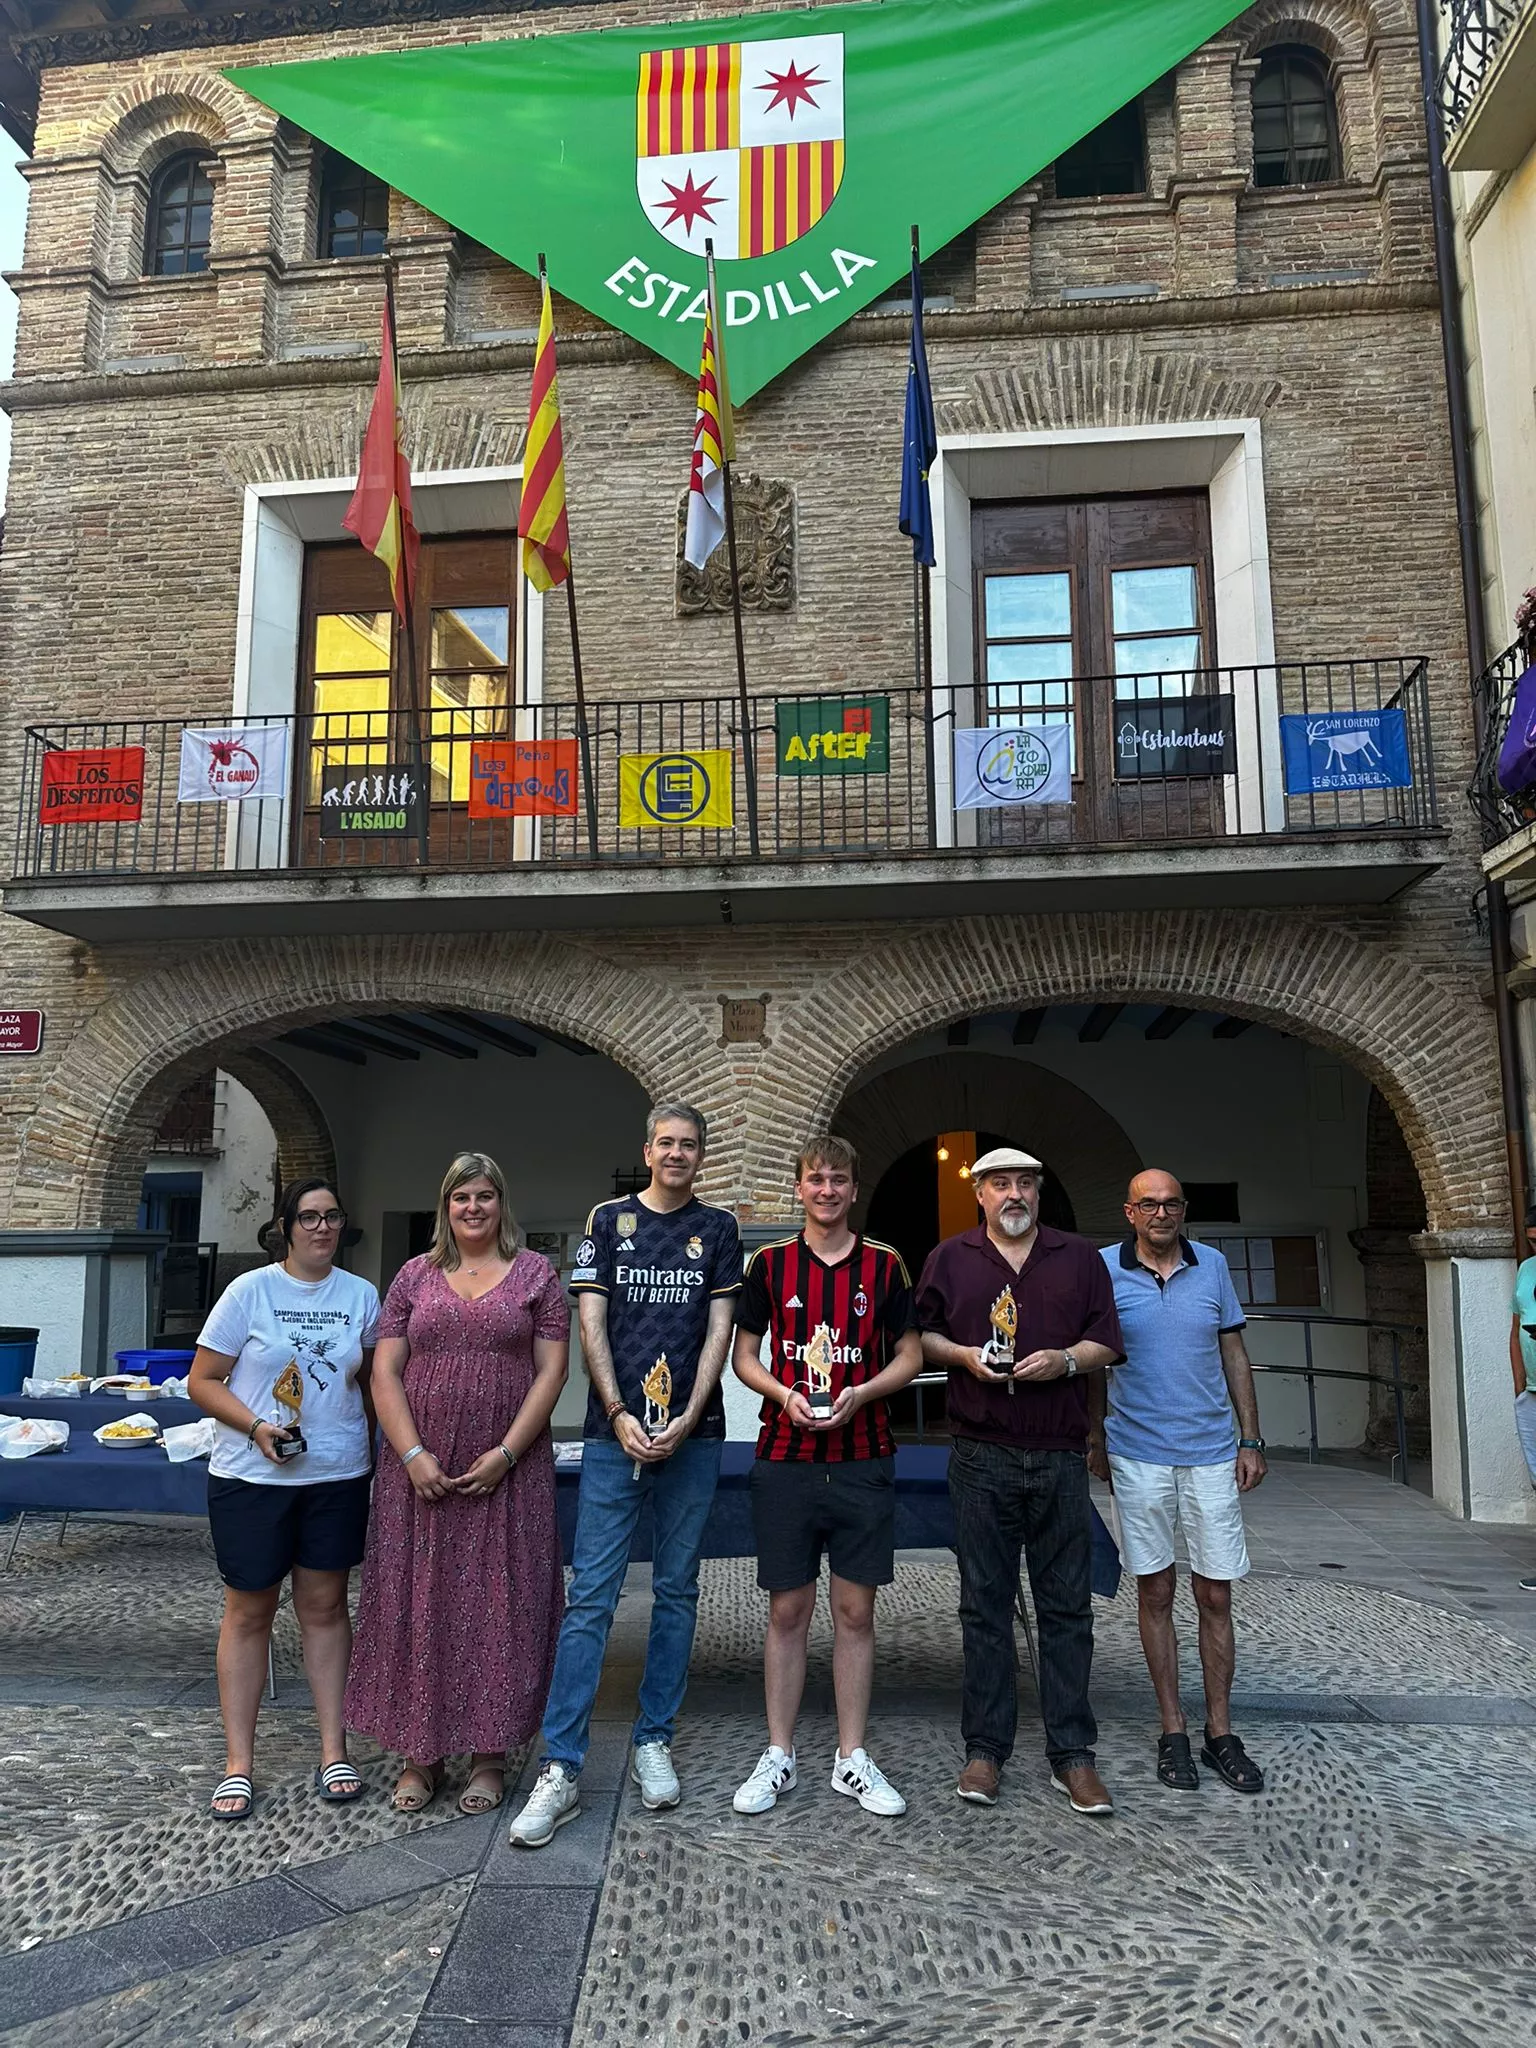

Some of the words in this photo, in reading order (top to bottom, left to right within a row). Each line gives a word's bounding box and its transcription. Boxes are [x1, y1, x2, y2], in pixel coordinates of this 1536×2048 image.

[1325, 719, 1341, 729] SAN
[1344, 717, 1380, 728] LORENZO
[1142, 728, 1224, 750] Estalentaus
[77, 768, 109, 784] LOS
[216, 771, 224, 782] EL
[1312, 772, 1392, 788] ESTADILLA
[46, 784, 139, 808] DESFEITOS
[341, 809, 407, 829] L'ASADÓ
[0, 1015, 21, 1023] LAZA
[0, 1027, 21, 1035] AYOR
[616, 1265, 704, 1285] Emirates
[627, 1286, 646, 1302] FLY
[648, 1287, 690, 1304] BETTER
